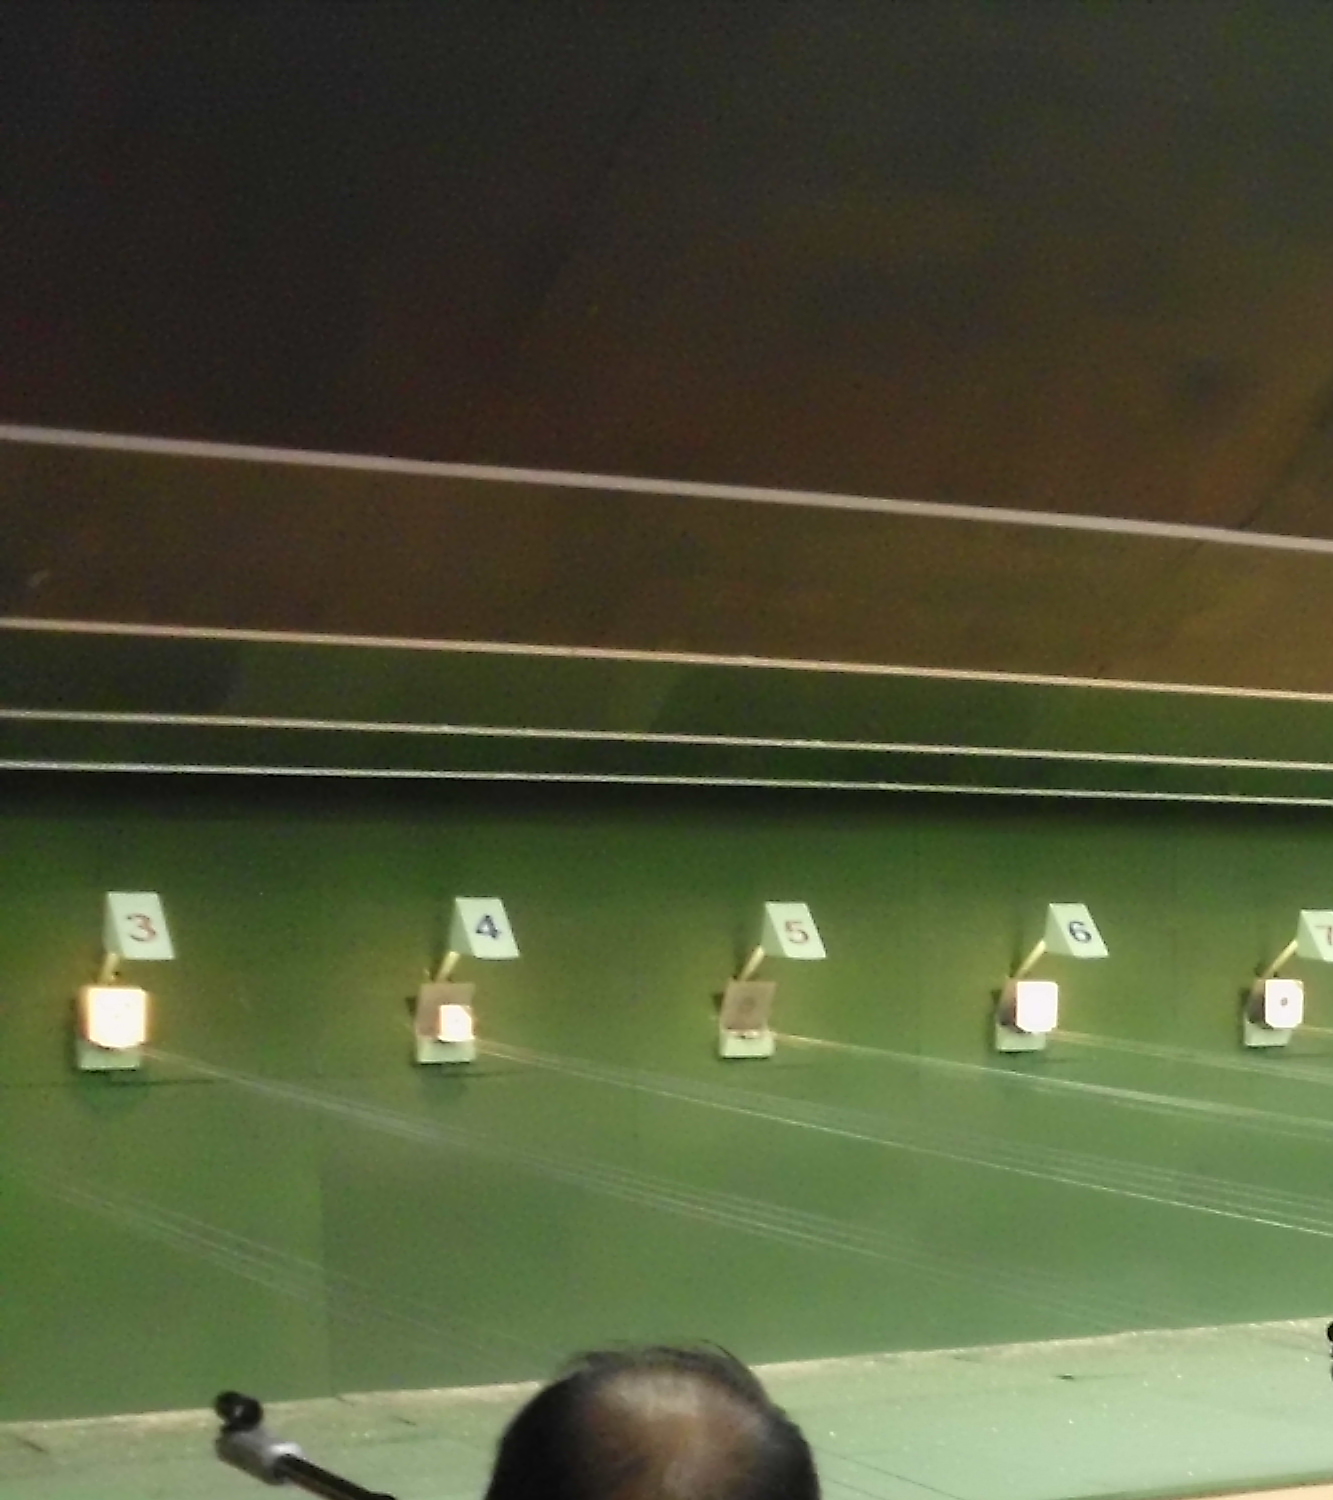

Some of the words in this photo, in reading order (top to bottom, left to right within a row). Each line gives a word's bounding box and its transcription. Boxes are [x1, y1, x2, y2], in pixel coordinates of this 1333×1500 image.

[127, 914, 155, 942] 3
[476, 916, 501, 939] 4
[785, 921, 809, 944] 5
[1069, 921, 1092, 944] 6
[1317, 925, 1333, 946] 7
